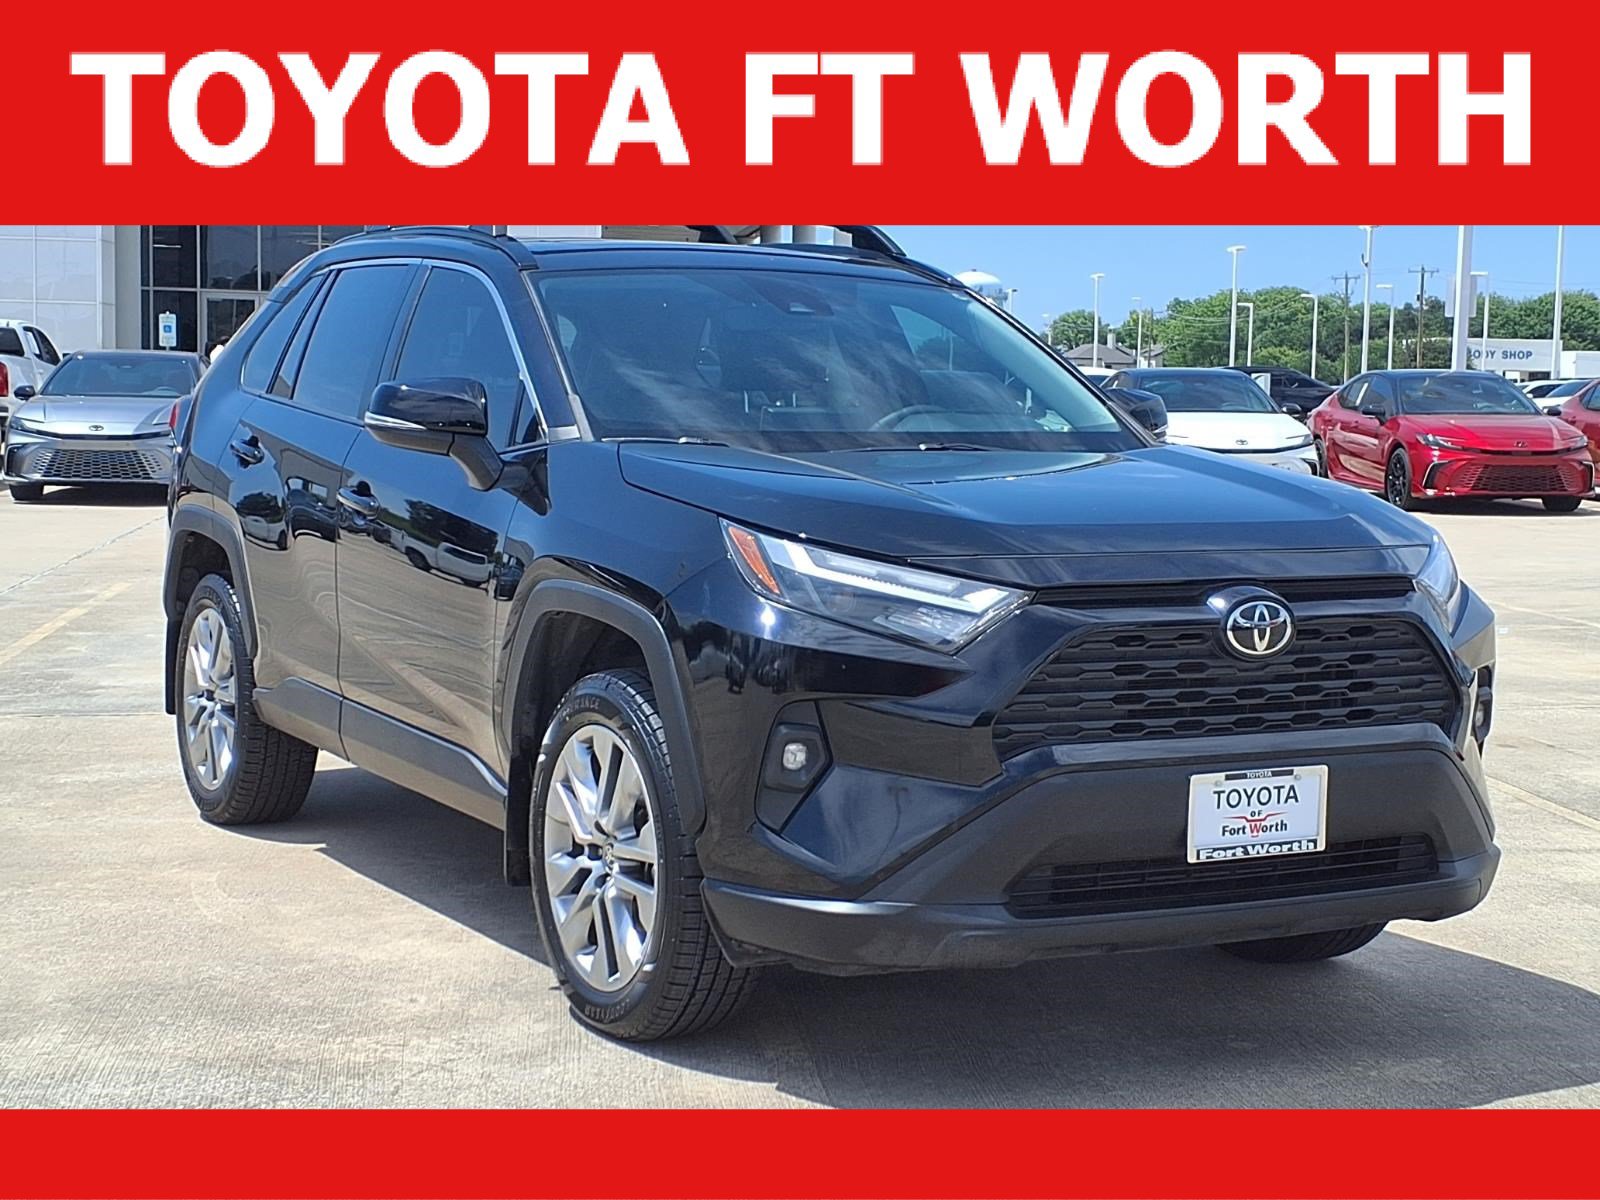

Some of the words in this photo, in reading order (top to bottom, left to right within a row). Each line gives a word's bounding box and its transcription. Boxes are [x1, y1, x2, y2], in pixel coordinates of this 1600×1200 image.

[1502, 350, 1533, 359] SHOP
[1246, 770, 1272, 779] TOYOTA
[1213, 785, 1299, 809] TOYOTA
[1222, 824, 1247, 836] Fort
[1250, 820, 1288, 834] Worth
[1199, 847, 1244, 860] Fort
[1245, 840, 1315, 855] Worth
